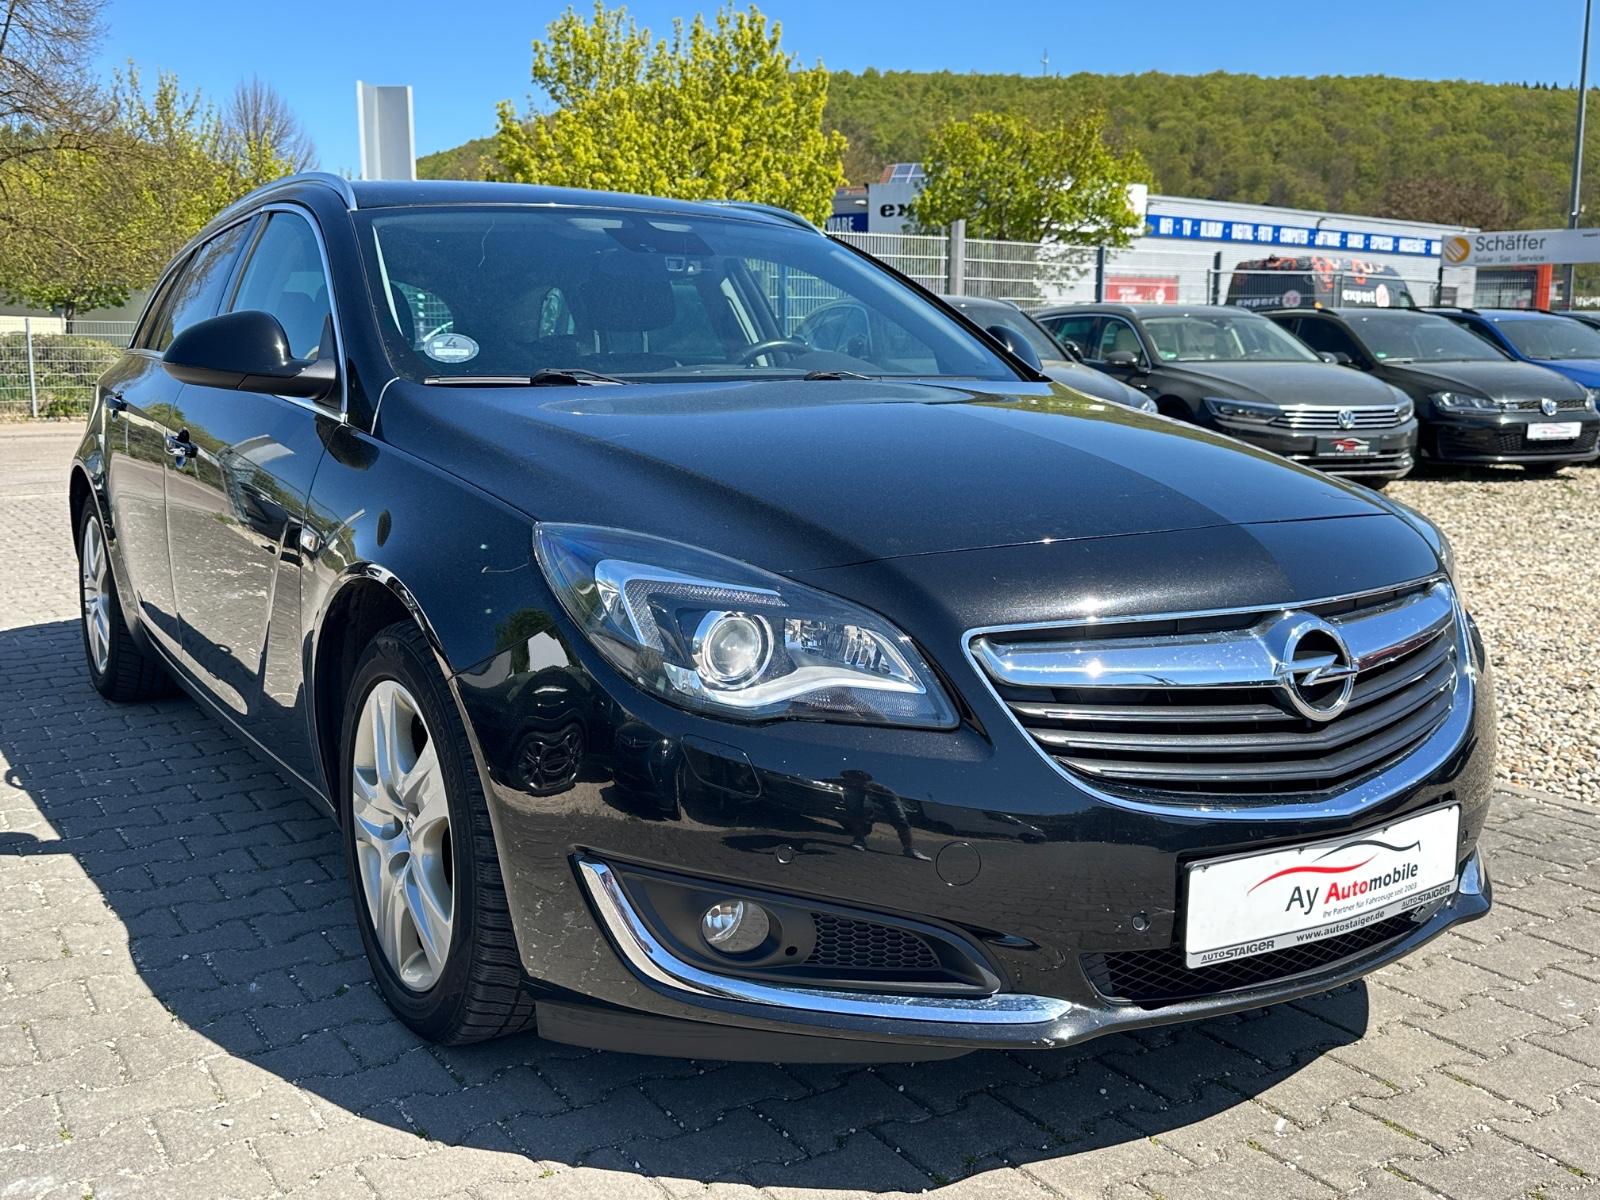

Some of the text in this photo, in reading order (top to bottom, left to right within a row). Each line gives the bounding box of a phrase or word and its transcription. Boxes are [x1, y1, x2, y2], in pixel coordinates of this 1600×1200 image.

[1182, 219, 1192, 236] TV
[1279, 227, 1309, 244] COMPUTER
[1475, 234, 1546, 253] Schäffer
[1517, 254, 1545, 263] Service
[1235, 297, 1280, 308] expert
[1342, 290, 1375, 303] expert
[445, 337, 458, 348] 4
[1285, 863, 1418, 915] Ay Automobile
[1333, 904, 1355, 914] Partner
[1355, 901, 1365, 911] für
[1365, 891, 1393, 906] Fahrzeuge
[1296, 910, 1385, 942] www.autostaiger.de
